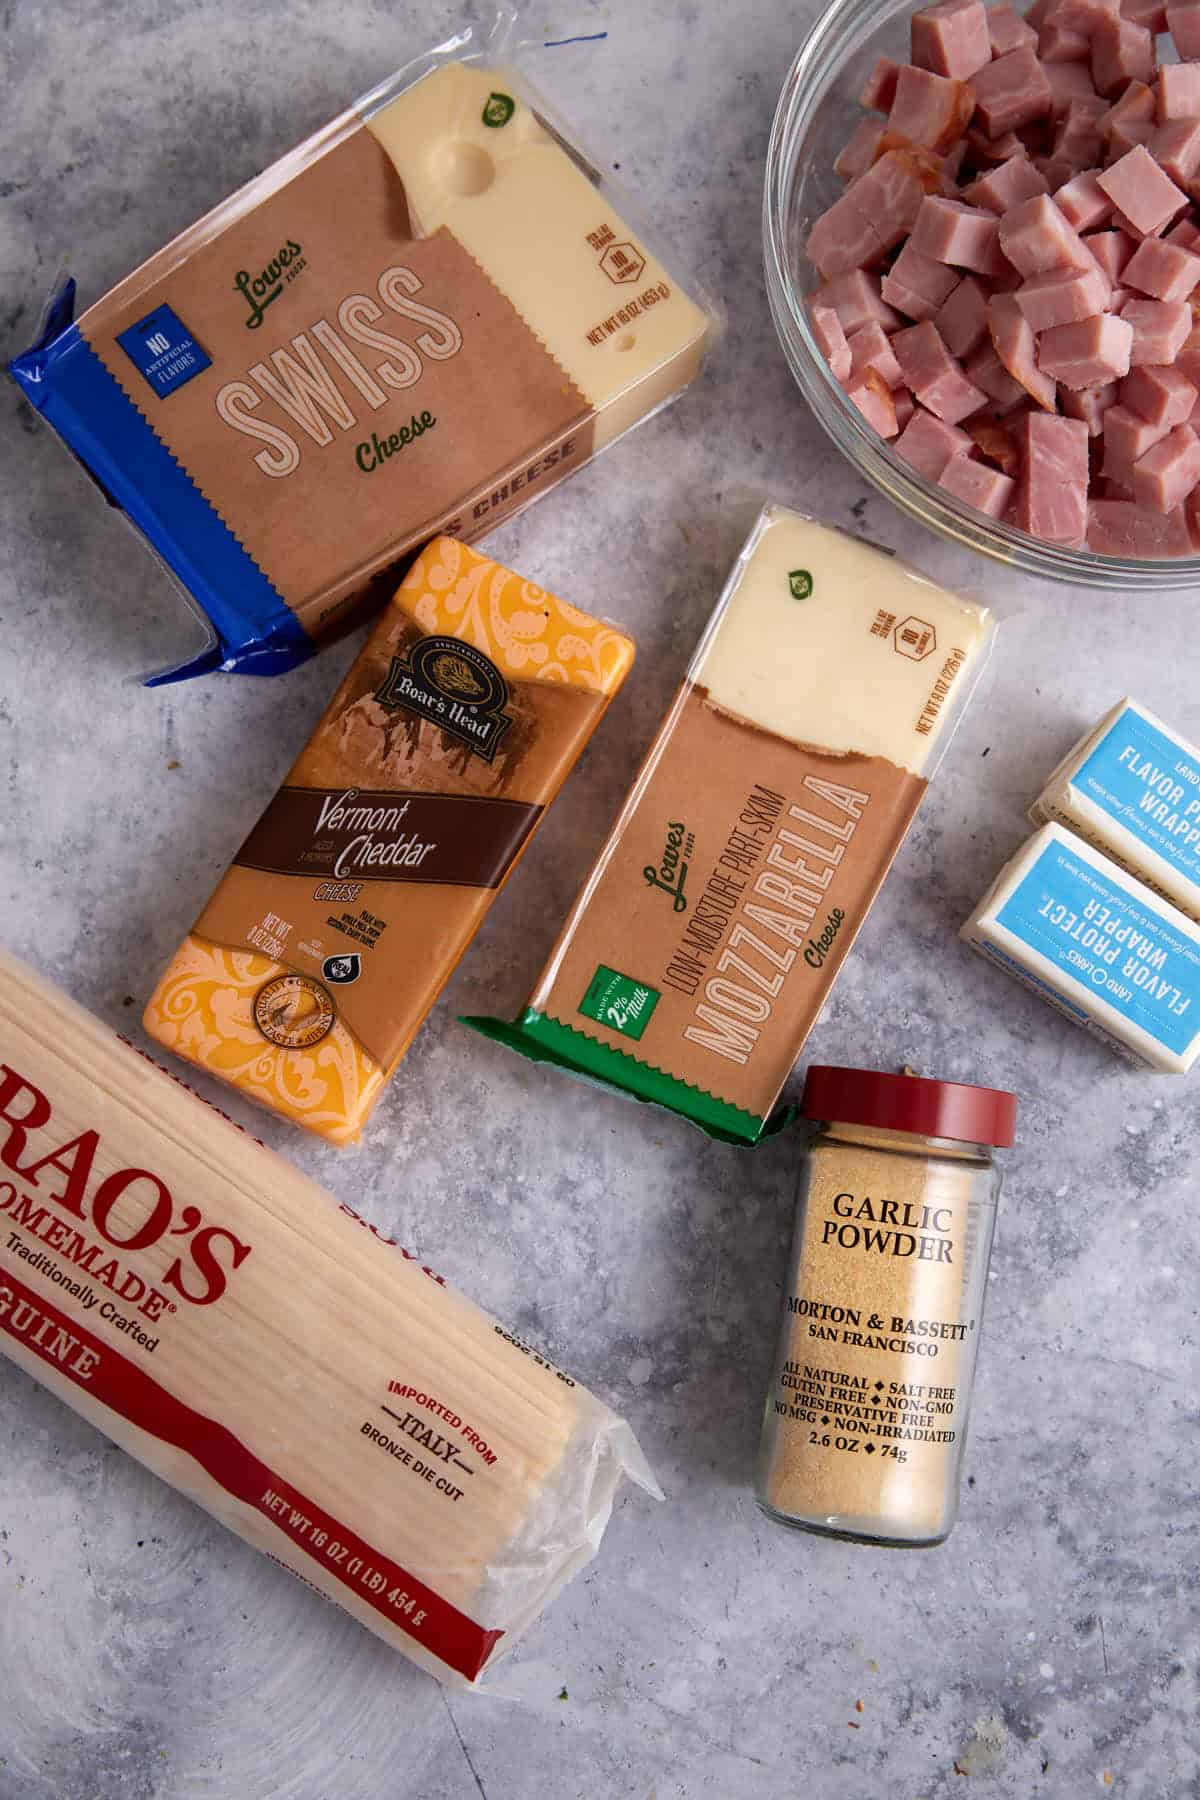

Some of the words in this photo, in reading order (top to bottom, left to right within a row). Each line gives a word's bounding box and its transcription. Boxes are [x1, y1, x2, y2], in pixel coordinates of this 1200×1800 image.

[232, 240, 301, 329] Lowes
[146, 332, 170, 356] NO
[587, 326, 607, 346] NET
[602, 316, 621, 334] WT
[626, 301, 642, 318] OZ
[144, 339, 193, 376] ARTIFICIAL
[158, 352, 196, 384] FLAVORS
[215, 265, 463, 478] SWISS
[354, 410, 437, 472] Cheese
[472, 437, 577, 520] CHEESE
[396, 677, 447, 713] Boar's
[448, 702, 491, 739] Head
[923, 698, 941, 717] WT
[931, 692, 944, 702] 8
[934, 678, 950, 695] OZ
[915, 715, 934, 736] NET
[1118, 744, 1186, 806] FLAVOR
[314, 788, 411, 835] Vermont
[334, 832, 437, 879] Cheddar
[642, 821, 688, 912] Lowes
[314, 882, 364, 903] CHEESE
[662, 868, 748, 996] LOW-MOISTURE
[719, 784, 788, 877] PART-SKIM
[262, 911, 280, 930] NET
[276, 921, 294, 937] WT
[682, 774, 871, 1065] MOZZARELLA
[803, 907, 845, 968] Cheese
[1038, 898, 1121, 965] PROTECT
[1082, 899, 1168, 971] WRAPPER
[596, 996, 609, 1020] MADE
[605, 976, 622, 995] WITH
[626, 986, 649, 1020] Milk
[1106, 978, 1134, 1004] LAND
[1122, 956, 1192, 1016] FLAVOR
[608, 997, 628, 1029] 2%
[0, 1064, 252, 1305] RAO'S
[833, 1193, 953, 1233] GARLIC
[822, 1221, 953, 1263] POWDER
[6, 1231, 100, 1309] Traditionally
[100, 1301, 160, 1353] Crafted
[787, 1296, 862, 1327] MORTON
[867, 1313, 884, 1330] &
[891, 1316, 968, 1341] BASSETT
[808, 1324, 838, 1342] SAN
[842, 1331, 939, 1358] FRANCISCO
[781, 1375, 826, 1396] GLUTEN
[830, 1386, 867, 1404] FREE
[886, 1396, 954, 1415] NON-GMO
[783, 1361, 801, 1376] ALL
[803, 1365, 870, 1390] NATURAL
[889, 1382, 926, 1398] SALT
[928, 1387, 956, 1400] FREE
[388, 1380, 462, 1428] IMPORTED
[460, 1426, 498, 1466] FROM
[774, 1400, 788, 1416] NO
[788, 1405, 817, 1424] MSG
[834, 1417, 956, 1444] NON-IRRADIATED
[794, 1393, 898, 1424] PRESERVATIVE
[901, 1413, 935, 1428] FREE
[398, 1412, 461, 1463] ITALY
[809, 1431, 830, 1446] 2.6
[835, 1437, 860, 1453] OZ
[881, 1445, 908, 1463] 74g
[360, 1422, 414, 1466] BRONZE
[412, 1461, 436, 1482] DIE
[436, 1478, 464, 1502] CUT
[262, 1489, 291, 1517] NET
[288, 1510, 312, 1534] WT
[309, 1527, 328, 1548] 16
[326, 1542, 349, 1564] OZ
[346, 1557, 364, 1576] (1
[360, 1568, 388, 1595] LB)
[387, 1588, 416, 1616] 454
[411, 1610, 428, 1626] g
